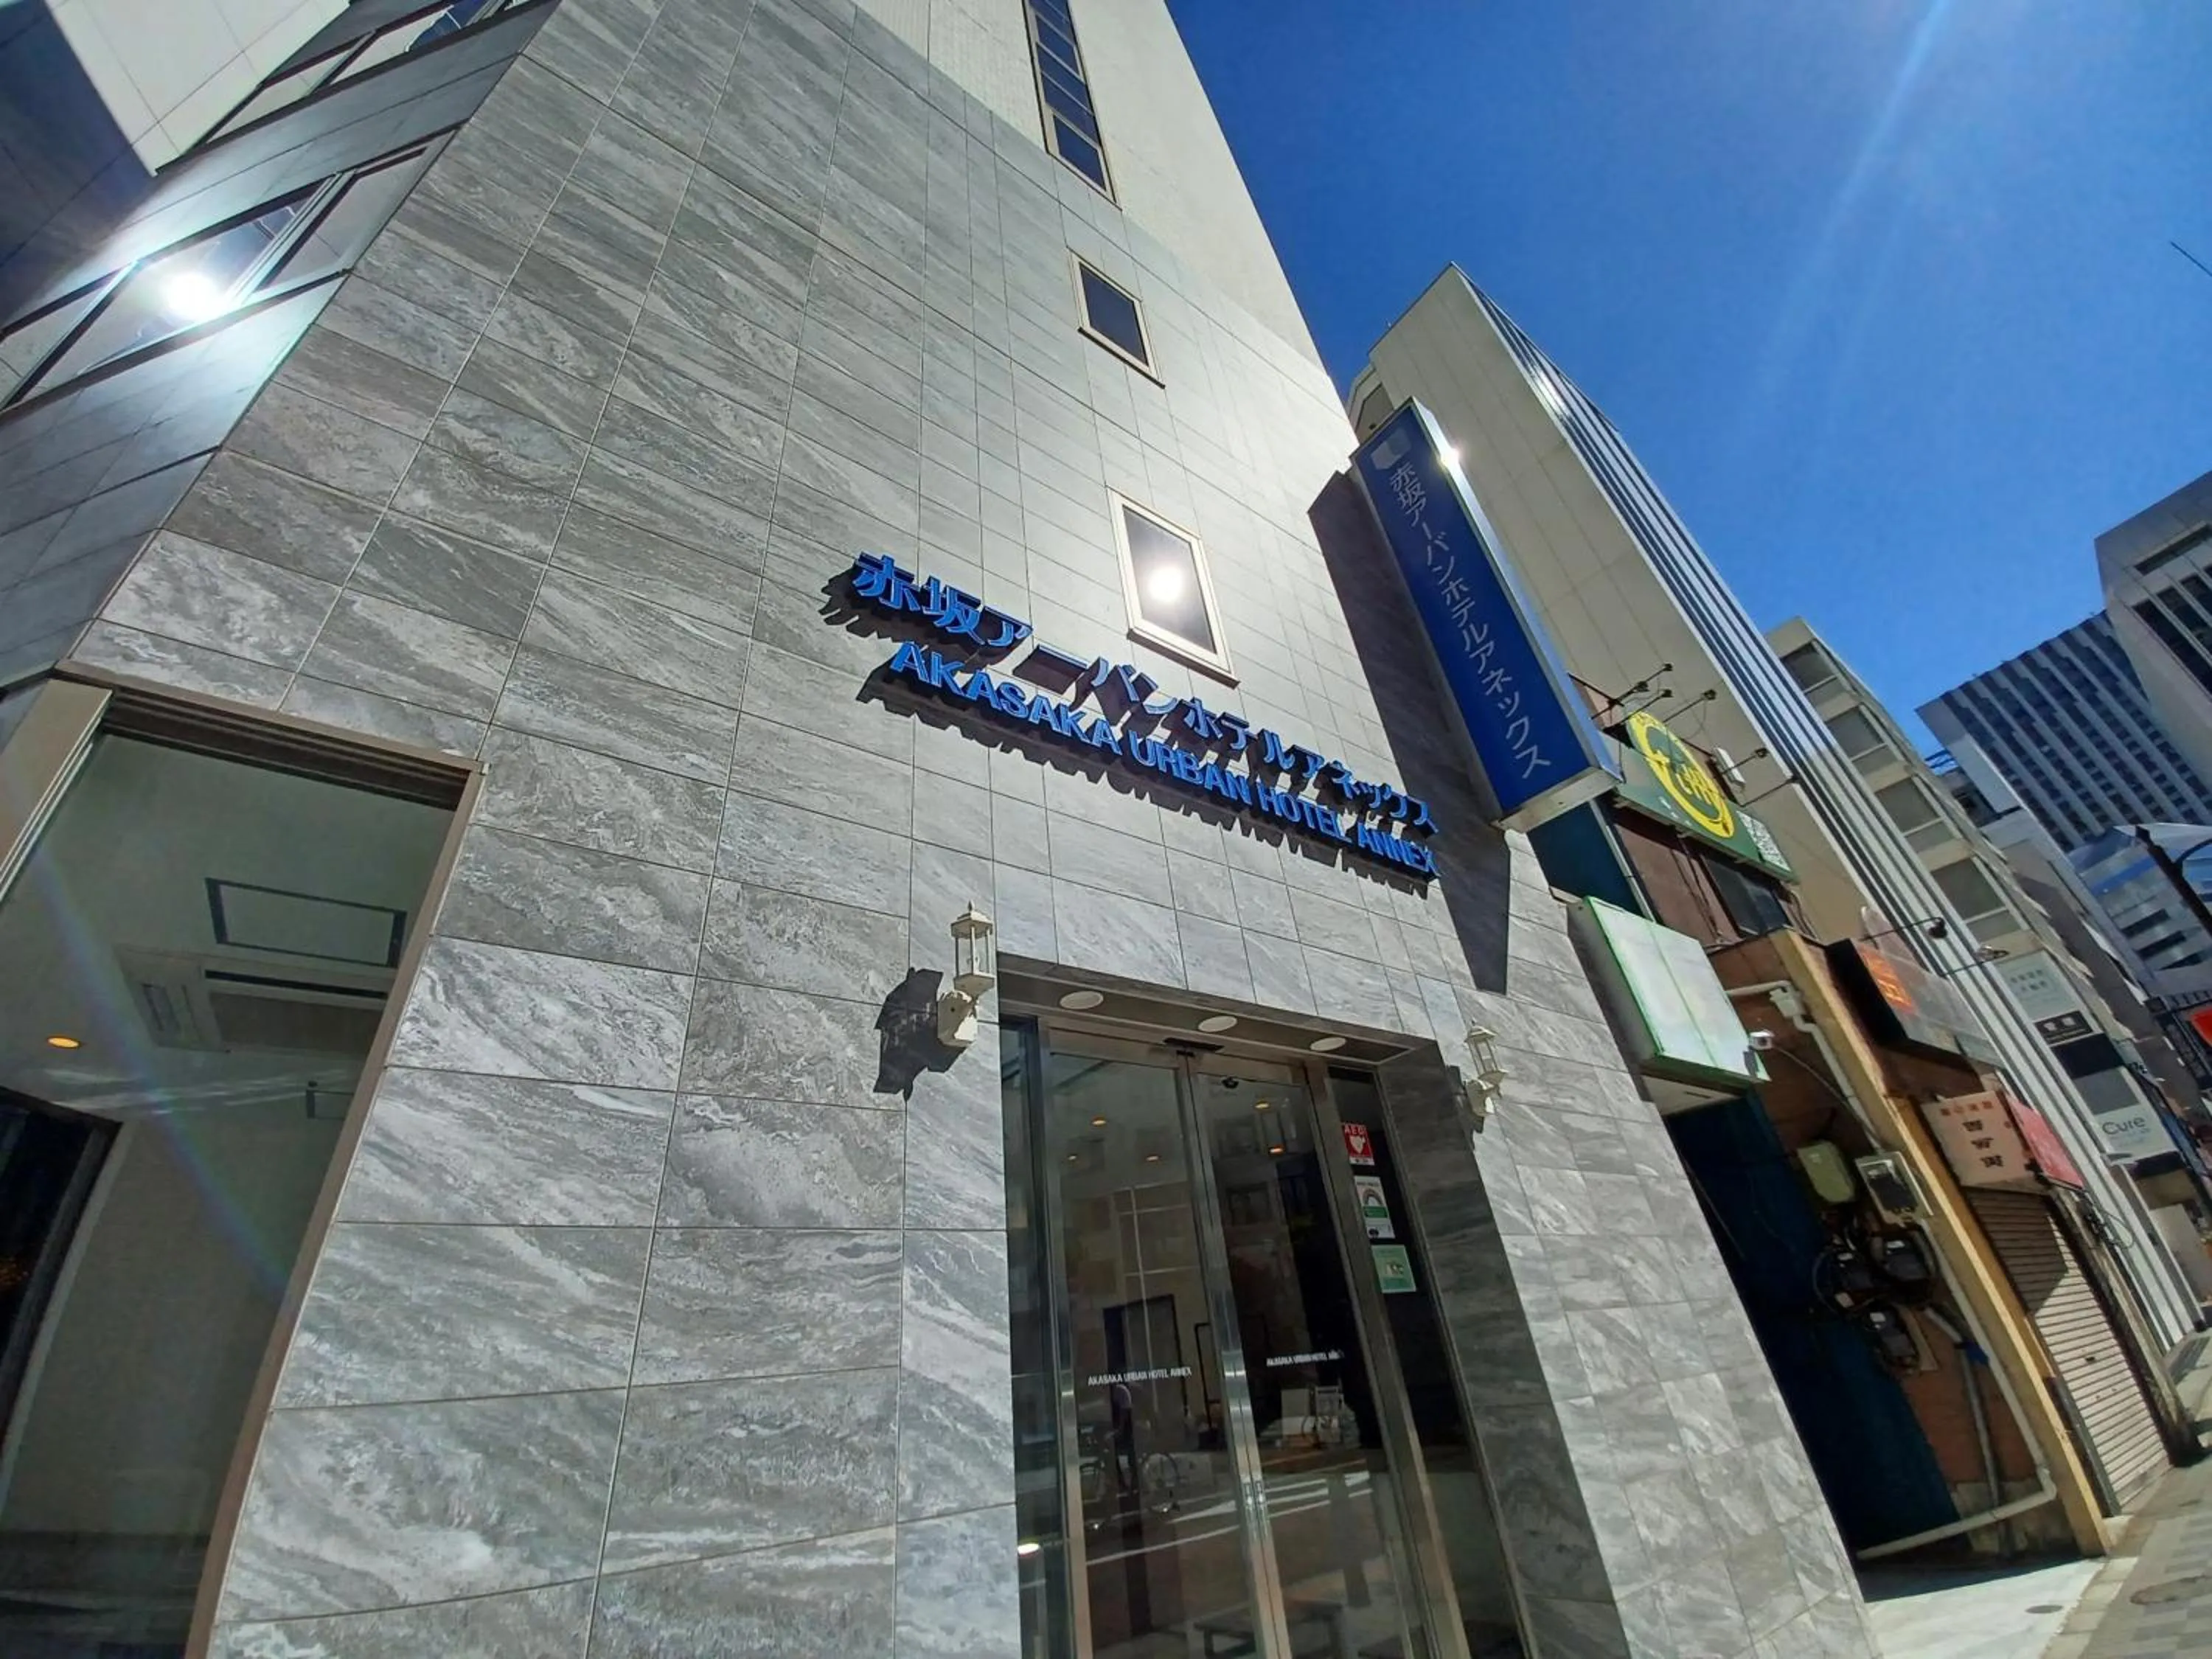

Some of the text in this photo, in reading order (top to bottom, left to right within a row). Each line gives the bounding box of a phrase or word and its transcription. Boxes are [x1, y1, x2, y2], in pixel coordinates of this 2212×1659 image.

[1389, 461, 1551, 779] 赤坂アーバンホテルアネックス
[852, 552, 1439, 834] 赤坂アーバンホテルアネックス
[890, 640, 1441, 877] AKASAKA URBAN HOTEL ANNEX
[1344, 1124, 1365, 1135] AED
[2102, 1117, 2146, 1135] Cure
[1088, 1374, 1122, 1386] AKASAKA
